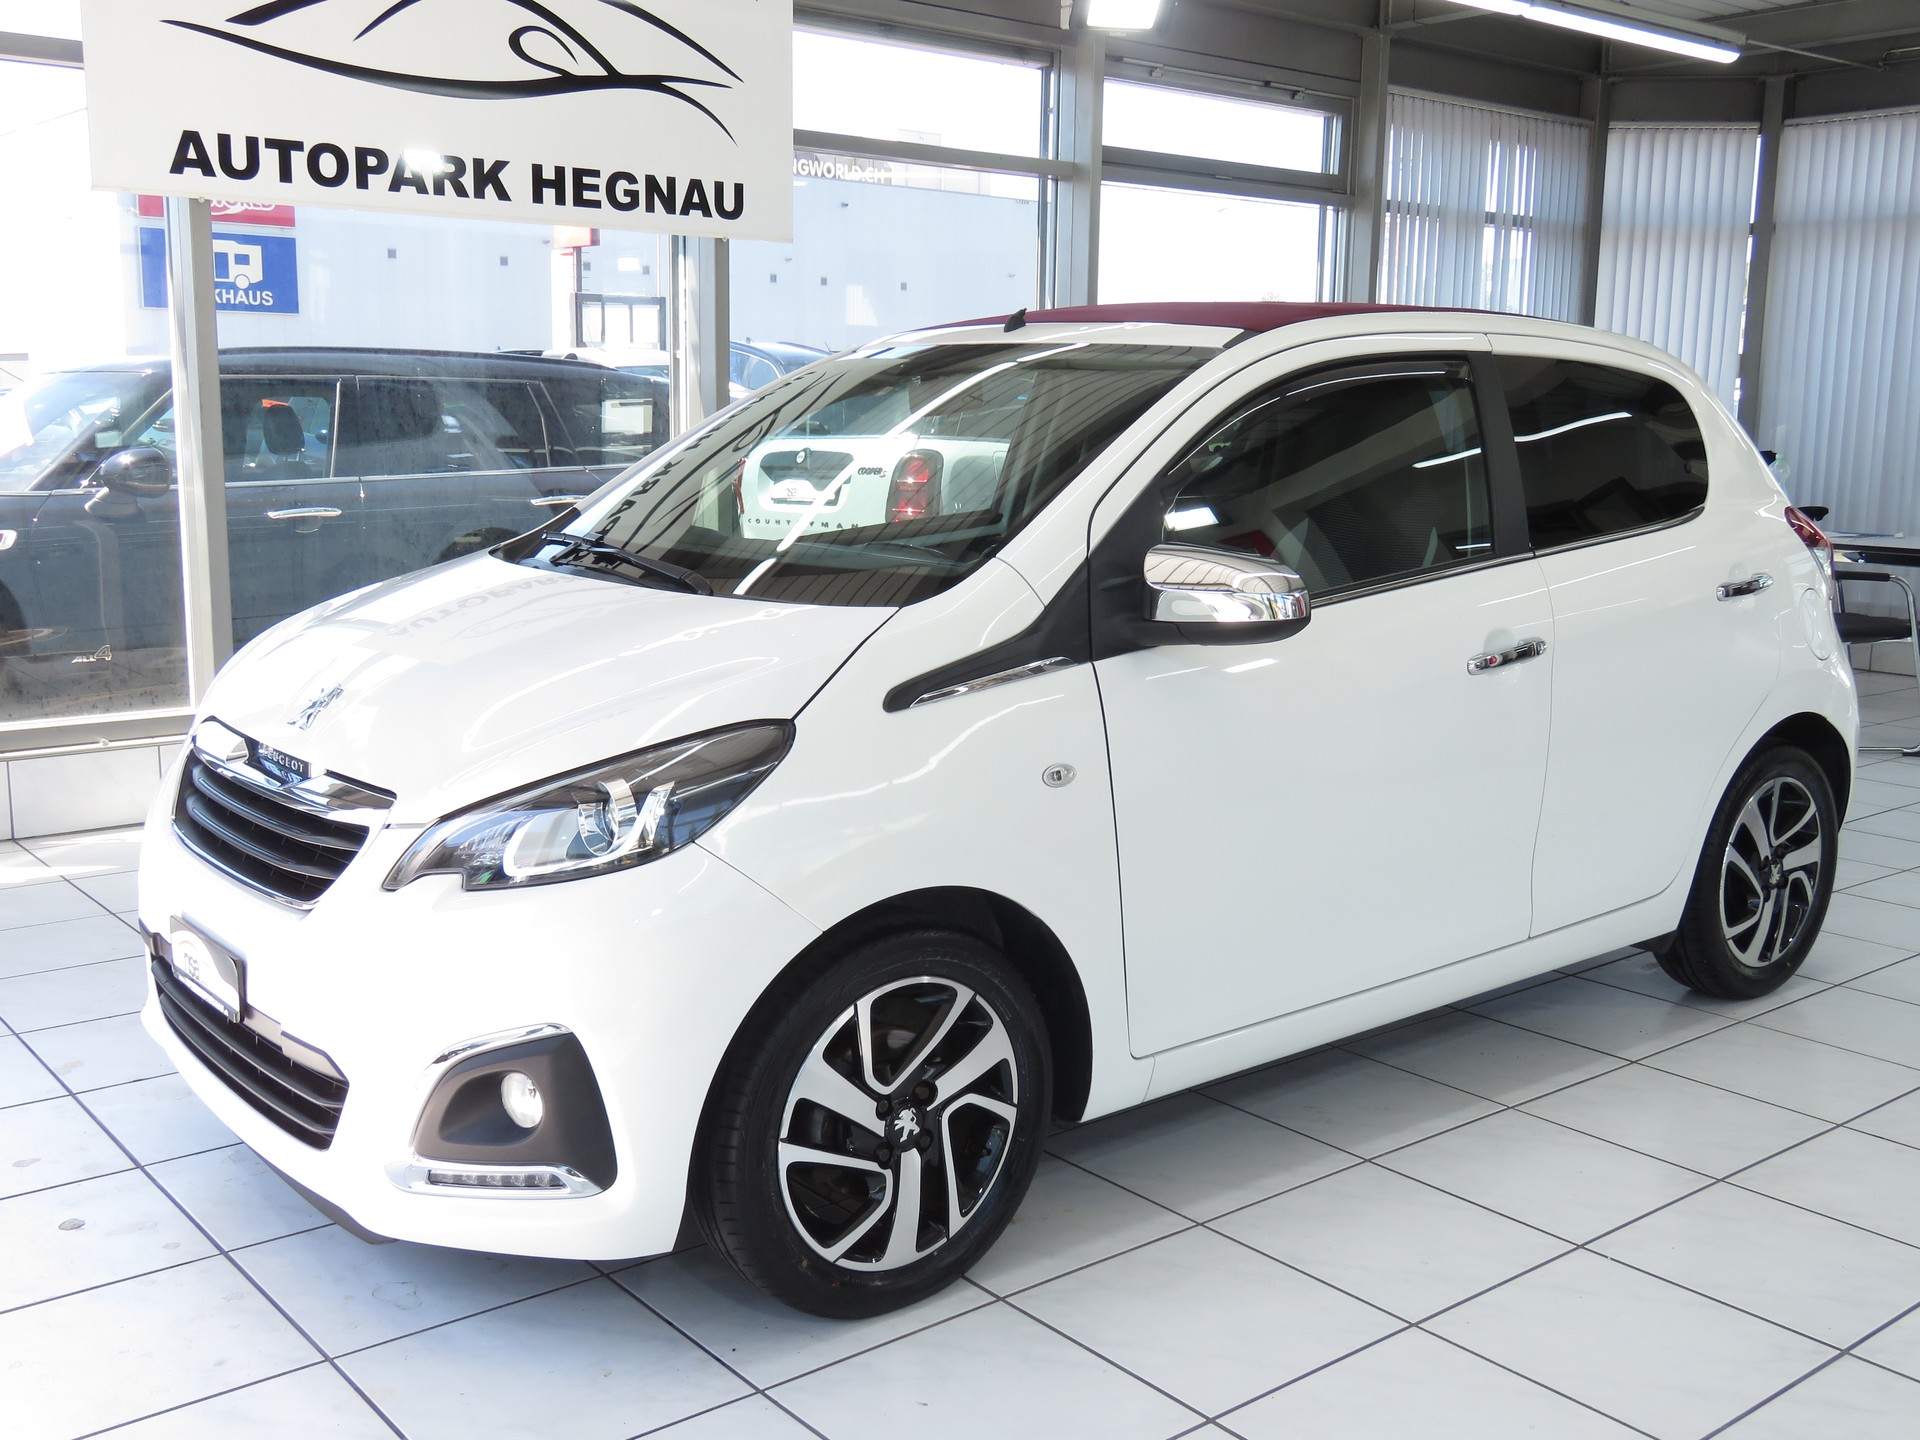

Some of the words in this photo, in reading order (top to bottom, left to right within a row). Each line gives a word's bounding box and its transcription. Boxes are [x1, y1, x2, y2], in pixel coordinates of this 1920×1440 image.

[169, 129, 512, 202] AUTOPARK
[531, 163, 744, 221] HEGNAU
[747, 518, 859, 529] COUNTYMAN
